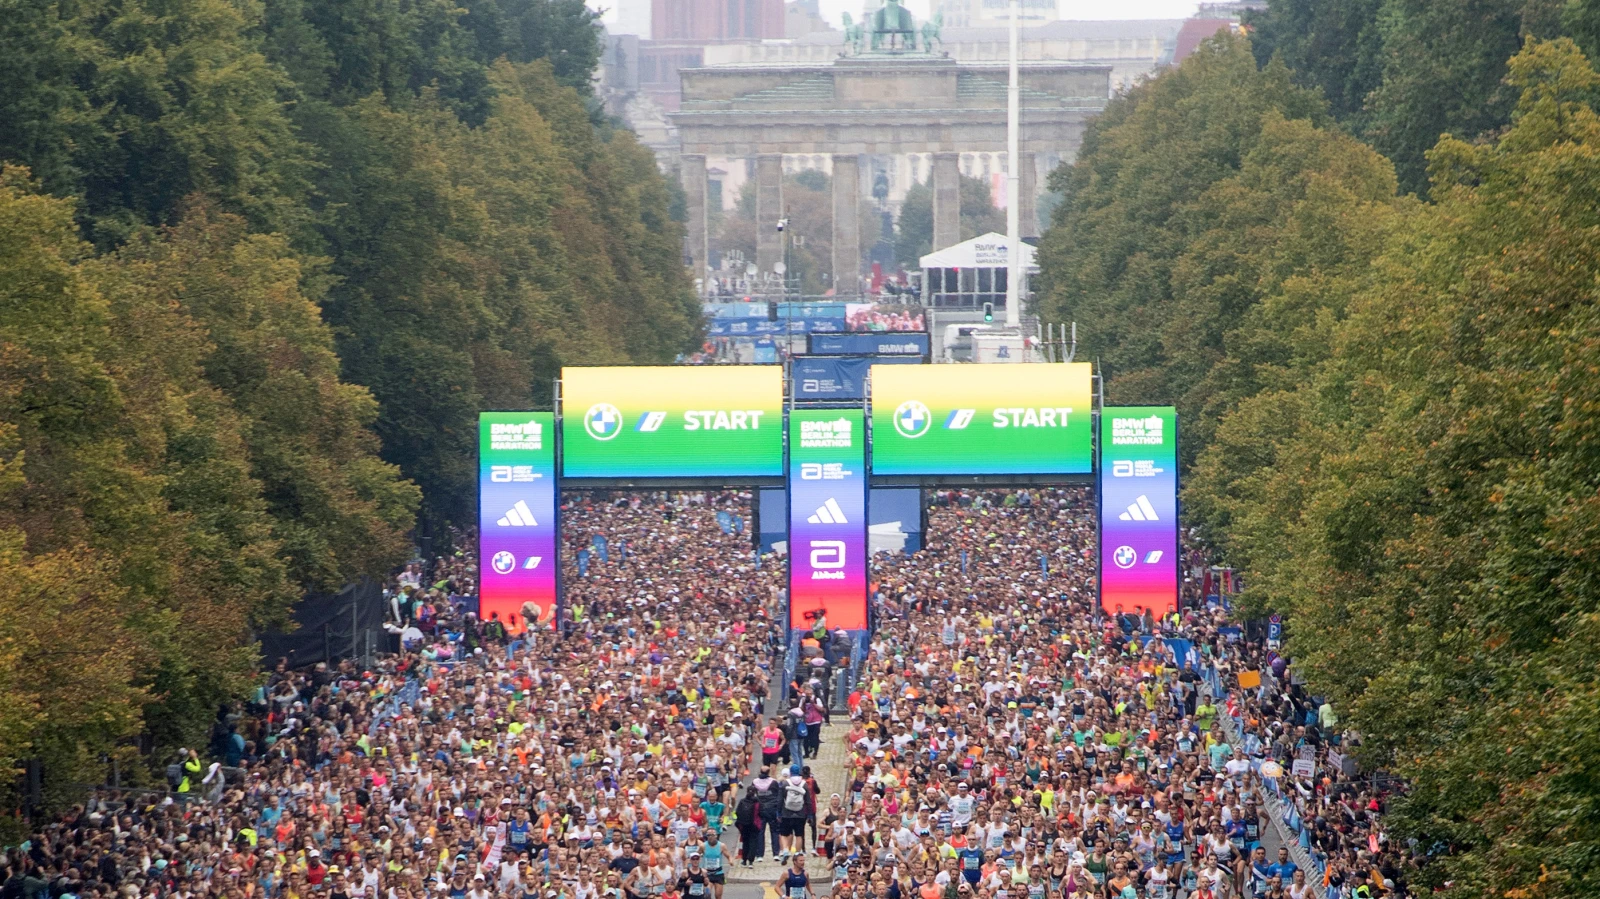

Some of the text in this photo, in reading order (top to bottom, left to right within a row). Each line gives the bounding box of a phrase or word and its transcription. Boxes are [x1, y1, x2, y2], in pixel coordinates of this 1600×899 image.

[878, 344, 904, 353] BMW
[684, 410, 765, 430] START
[993, 408, 1073, 428] START
[1112, 417, 1145, 429] BMW
[491, 423, 523, 434] BMW
[801, 421, 833, 432] BMW
[801, 431, 834, 440] BERLIN
[1112, 428, 1145, 437] BERLIN
[801, 439, 852, 448] MARATHON
[1112, 436, 1163, 445] MARATHON
[491, 442, 542, 450] MARATHON
[1270, 625, 1277, 638] P
